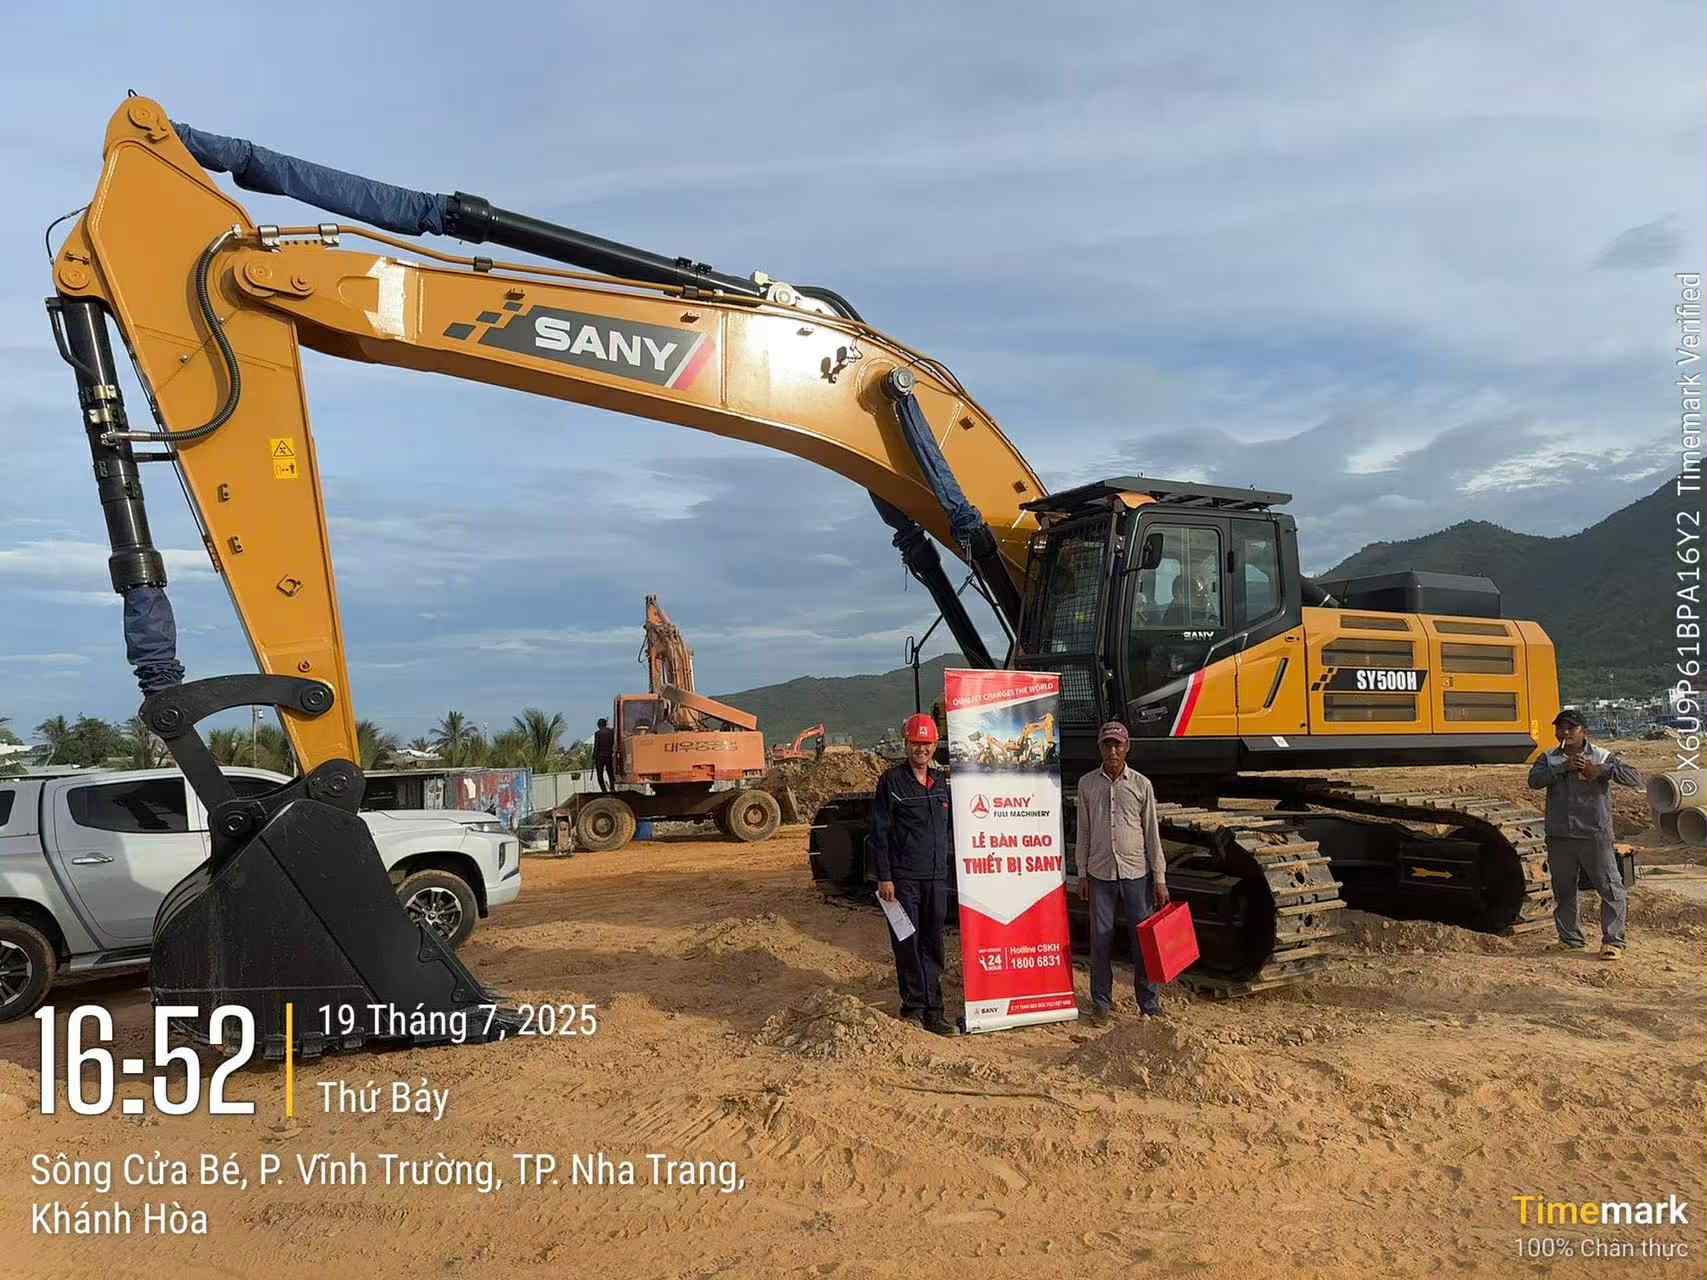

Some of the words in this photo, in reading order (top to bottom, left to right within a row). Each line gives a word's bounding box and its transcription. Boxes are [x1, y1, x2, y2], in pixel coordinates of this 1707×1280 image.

[535, 316, 678, 371] SANY
[1183, 631, 1214, 640] SANY
[1356, 670, 1417, 690] SY500H
[1029, 682, 1054, 693] WORLD
[993, 797, 1030, 808] SANY
[990, 832, 1018, 848] BÀN
[1022, 835, 1052, 847] GIAO
[963, 852, 1002, 874] THIẾT
[1007, 856, 1022, 876] BỊ
[1025, 856, 1062, 872] SANY
[1010, 945, 1036, 955] Hotline
[1037, 943, 1060, 953] CSKH
[987, 955, 1002, 966] 24
[1011, 957, 1034, 969] 1800
[1037, 955, 1060, 968] 6831
[981, 1007, 999, 1015] SANY
